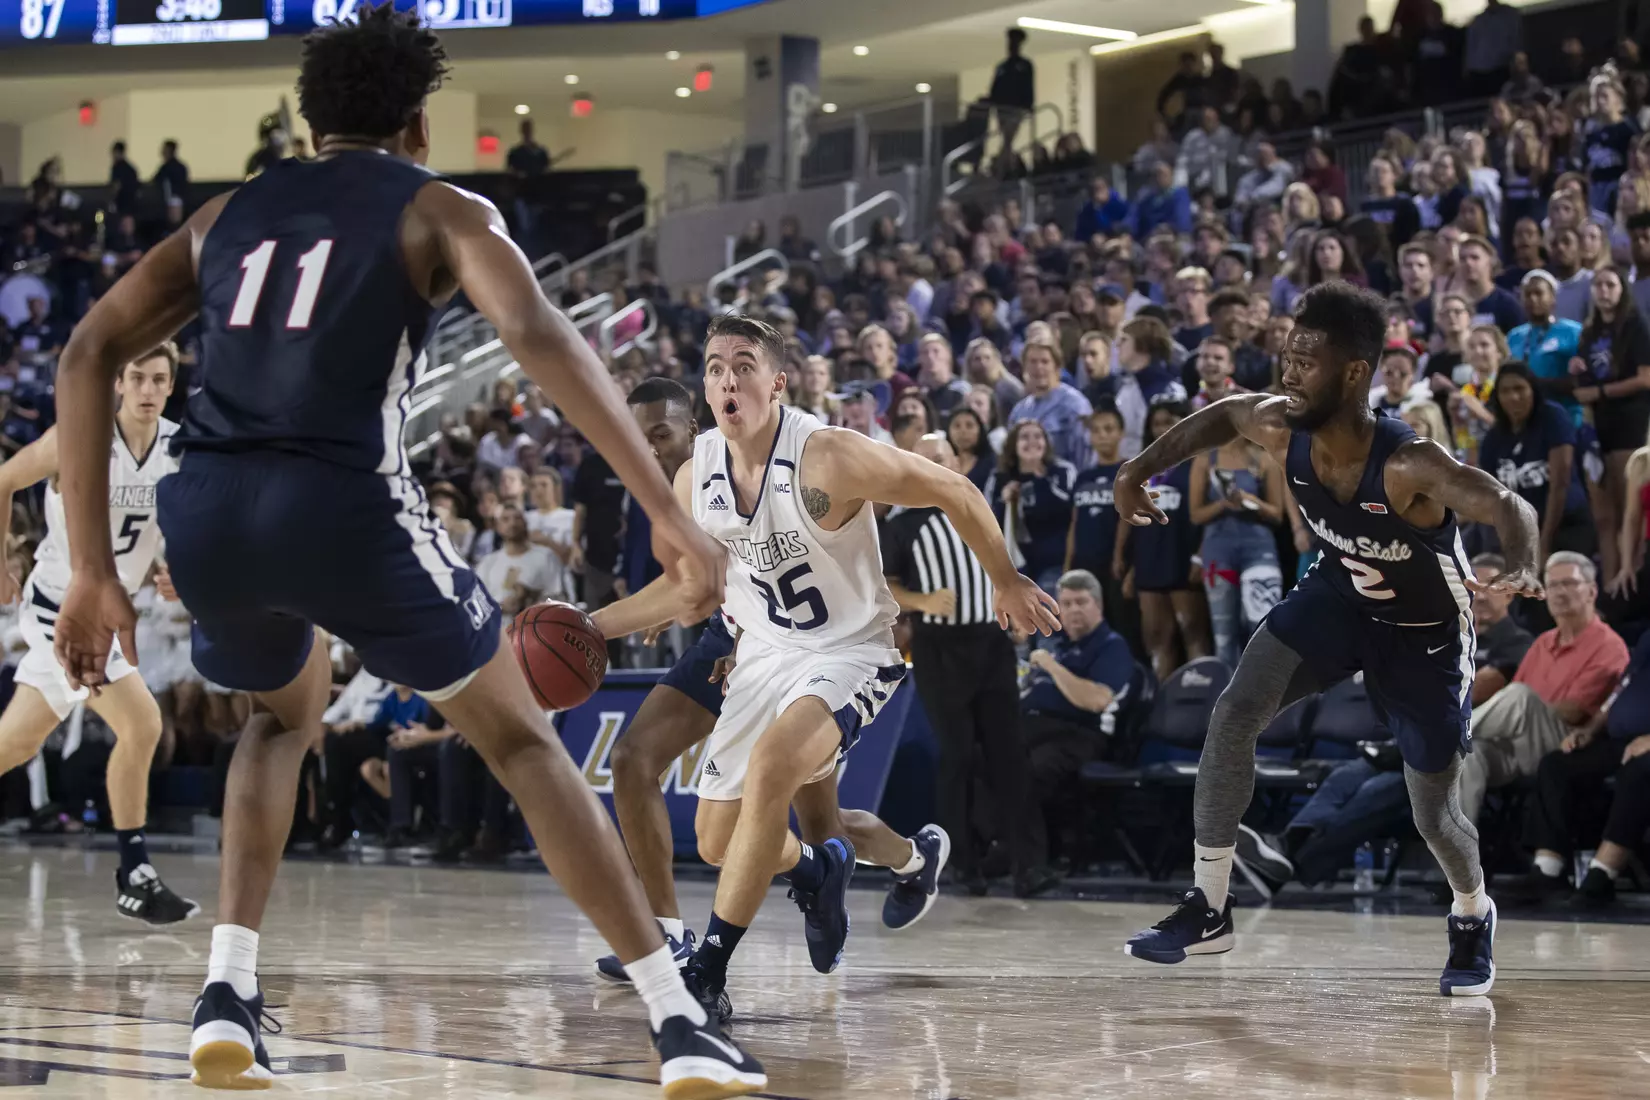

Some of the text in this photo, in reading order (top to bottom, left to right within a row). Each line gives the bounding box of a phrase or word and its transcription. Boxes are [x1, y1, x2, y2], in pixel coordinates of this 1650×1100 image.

[20, 0, 66, 39] 87
[227, 238, 335, 329] 11
[108, 485, 157, 508] ANCE
[773, 483, 790, 493] WAC
[114, 513, 150, 556] 5
[725, 530, 809, 573] LACERS
[1356, 536, 1413, 562] State
[1340, 556, 1397, 600] 2
